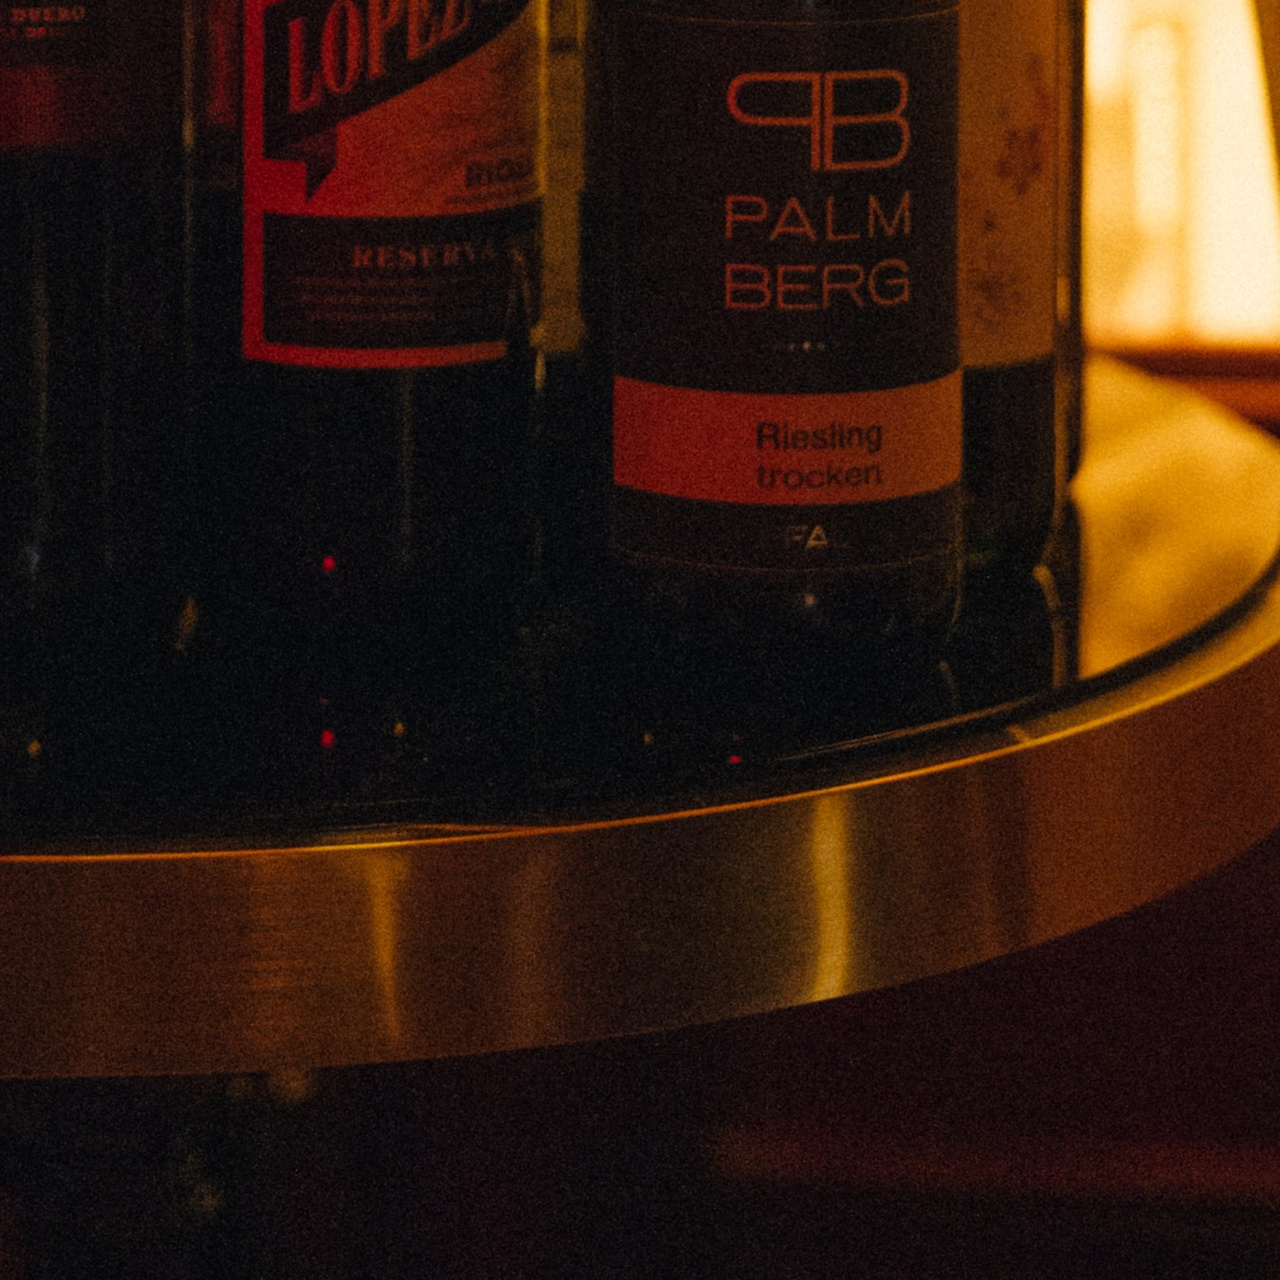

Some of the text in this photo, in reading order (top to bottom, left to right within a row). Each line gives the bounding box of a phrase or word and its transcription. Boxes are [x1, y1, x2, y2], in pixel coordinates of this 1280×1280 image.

[10, 4, 86, 24] DUERO
[724, 189, 912, 241] PALM
[724, 258, 912, 312] BERG
[756, 421, 883, 454] Riesling
[756, 460, 883, 490] trocken
